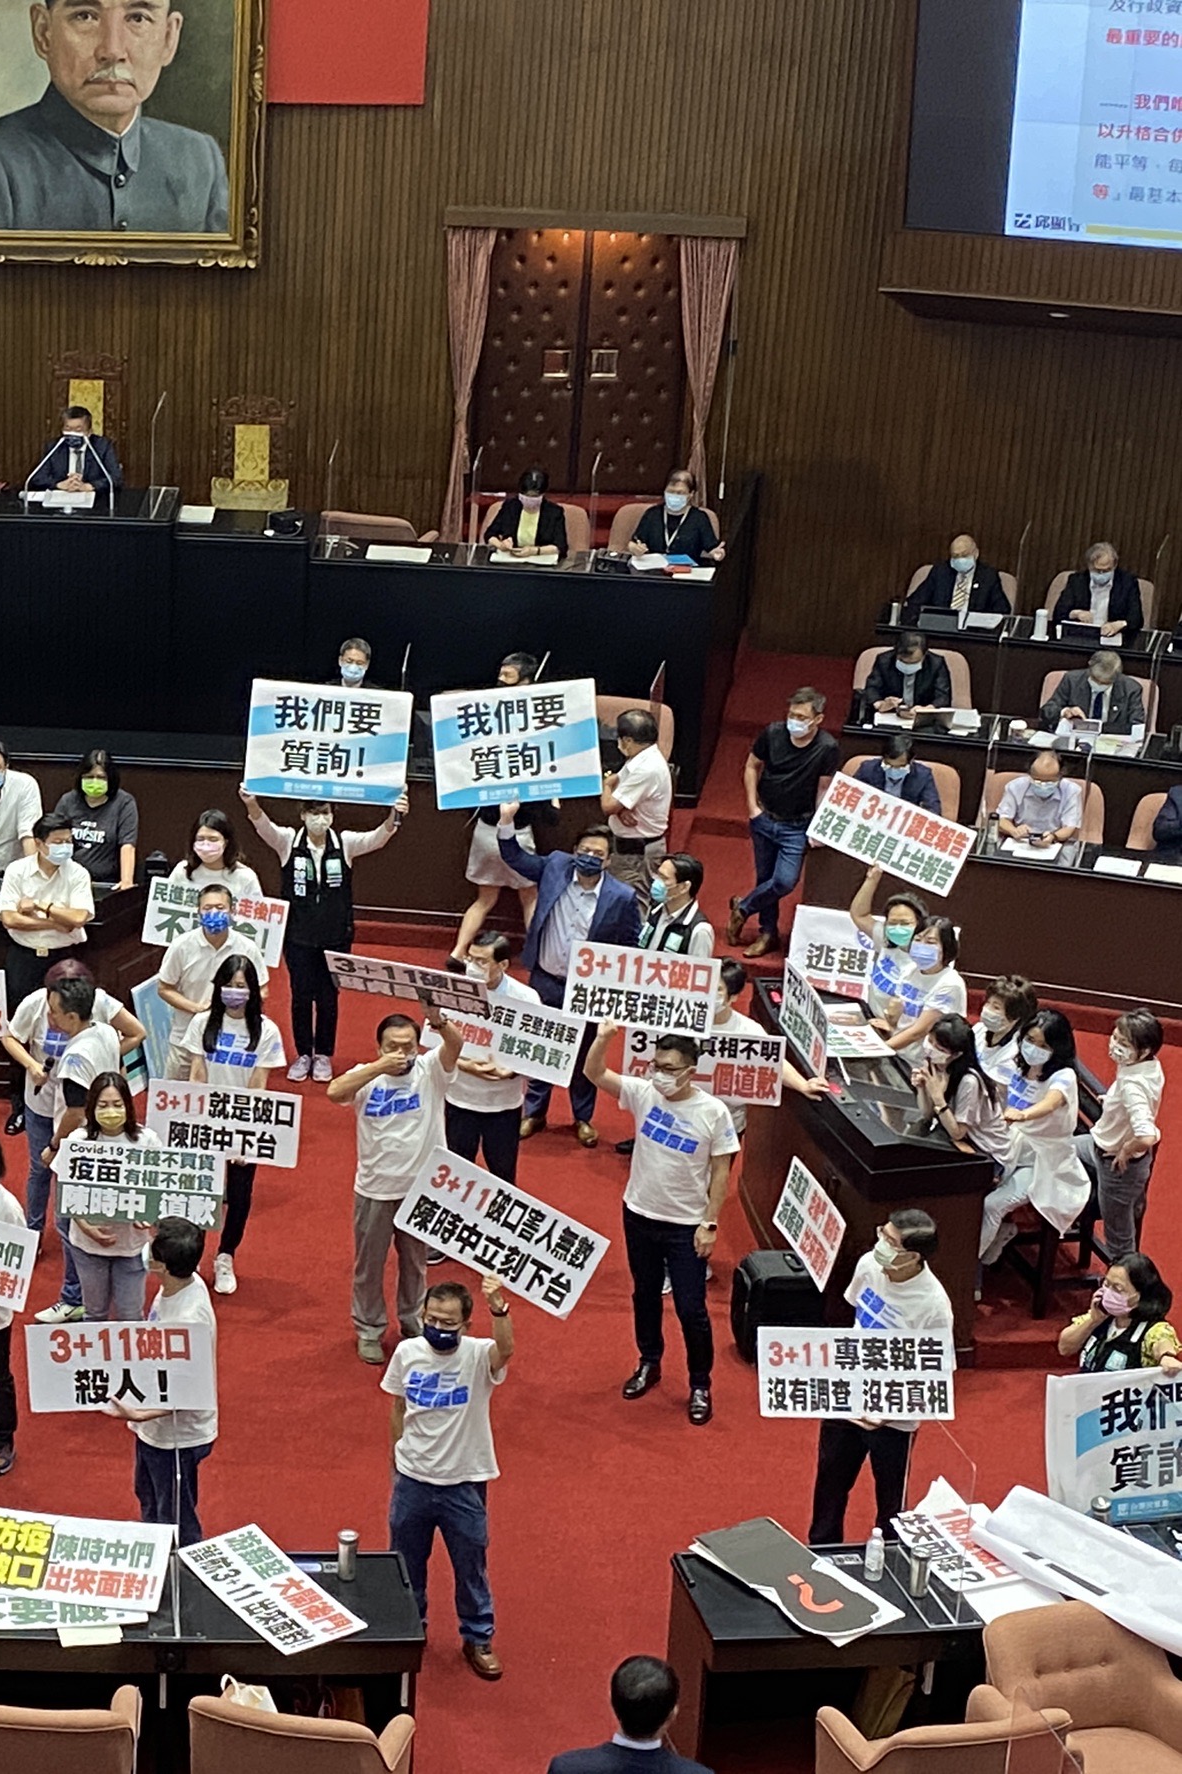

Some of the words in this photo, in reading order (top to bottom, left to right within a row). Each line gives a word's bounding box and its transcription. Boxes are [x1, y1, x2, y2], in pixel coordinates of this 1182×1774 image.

[275, 694, 382, 736] 我們要
[457, 693, 567, 739] 我們要
[280, 739, 366, 779] 質詢!
[470, 740, 560, 782] 質詢!
[232, 896, 285, 924] 走後門
[332, 956, 481, 998] 3+11破口
[575, 947, 714, 995] 3+11大破口
[155, 1089, 296, 1128] 3+11就是破口
[69, 1142, 124, 1157] Covid-19
[168, 1120, 278, 1161] 陳時中下台
[68, 1154, 124, 1184] 疫苗
[61, 1184, 147, 1220] 陳時中
[405, 1194, 572, 1310] 陳時中立刻下台
[49, 1327, 191, 1364] 3+11破口
[767, 1336, 945, 1373] 3+11專案報告
[74, 1368, 169, 1406] 殺人!
[767, 1376, 853, 1413] 沒有調查
[862, 1378, 950, 1415] 沒有真相
[51, 1533, 157, 1569] 陳時中們
[44, 1564, 159, 1601] 出來面對!
